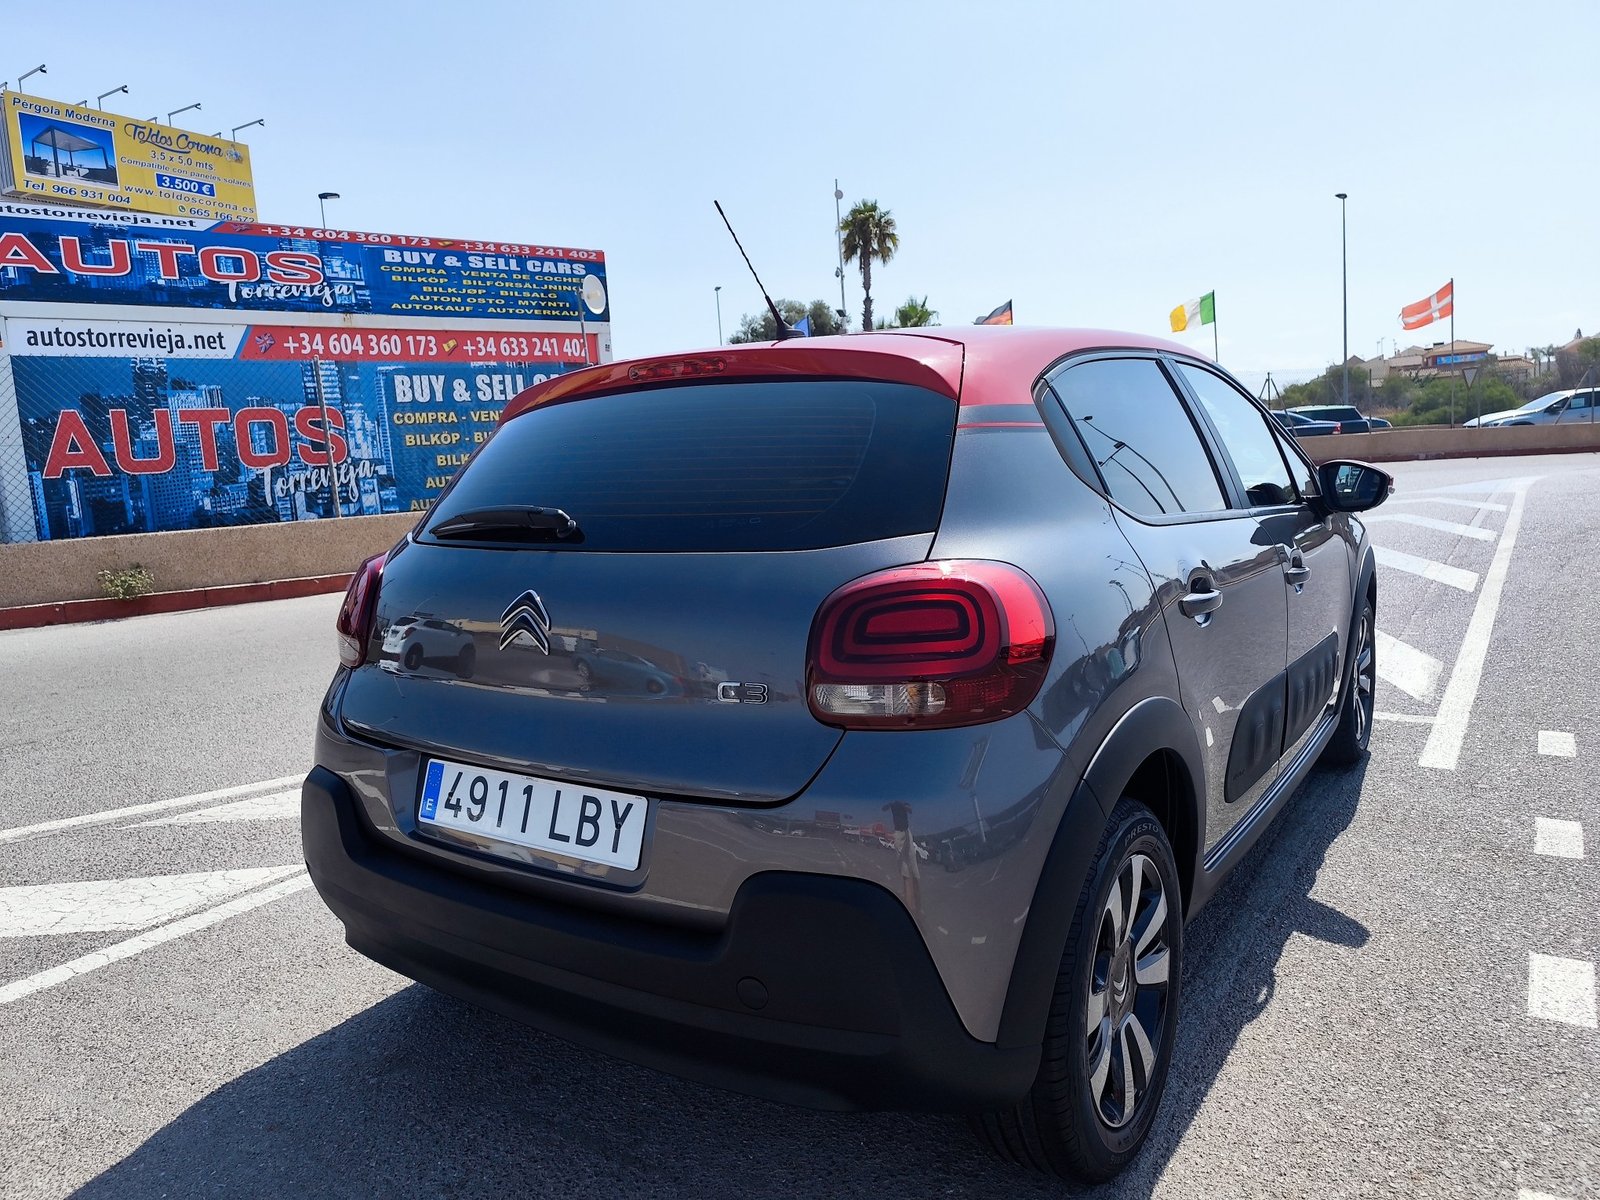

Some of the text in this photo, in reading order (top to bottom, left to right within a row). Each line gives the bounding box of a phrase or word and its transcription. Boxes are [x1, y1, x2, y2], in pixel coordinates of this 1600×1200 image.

[12, 97, 116, 128] Pérgola Moderna
[124, 123, 224, 158] Toldos Corona
[120, 156, 170, 172] Compatible
[190, 170, 222, 182] paneles
[223, 177, 252, 188] solares
[195, 161, 216, 172] mts.
[23, 179, 131, 205] Tel. 966 931 004
[161, 176, 211, 195] 3.500 €
[124, 185, 254, 214] www.toldoscorona.es
[0, 205, 197, 228] tostorrevieja.net
[189, 207, 210, 218] 665
[214, 211, 233, 221] 166
[261, 227, 597, 260] +34 604 360 173 +34 633 241 402
[0, 232, 324, 286] AUTOS
[383, 249, 587, 276] BUY & SELL CARS
[380, 265, 447, 275] COMPRA
[460, 270, 508, 279] VENTA
[535, 275, 584, 284] COCHE
[391, 275, 449, 284] BILKÖP
[220, 280, 353, 307] Torrevieja
[409, 294, 462, 303] AUTON
[466, 297, 505, 305] OSTO
[518, 300, 570, 308] MYYNTI
[422, 286, 487, 295] BILKJØP
[500, 290, 558, 299] BILSALG
[391, 303, 474, 312] AUTOKAUF
[487, 307, 585, 317] AUTOVERKAU
[26, 327, 226, 354] autostorrevieja.net
[283, 332, 324, 355] +34
[328, 333, 364, 355] 604
[367, 334, 402, 356] 360
[405, 335, 438, 356] 173
[463, 336, 497, 357] +34
[500, 337, 529, 357] 633
[532, 337, 559, 356] 241
[393, 374, 446, 403] BUY
[452, 378, 471, 403] &
[393, 410, 458, 425] COMPRA
[470, 410, 503, 422] VEN
[42, 406, 348, 479] AUTOS
[405, 431, 461, 447] BILKÖP
[257, 459, 376, 506] Torrevieja
[717, 681, 769, 705] C3
[424, 771, 634, 854] E 4911 LBY
[1124, 822, 1160, 847] PRESTO
